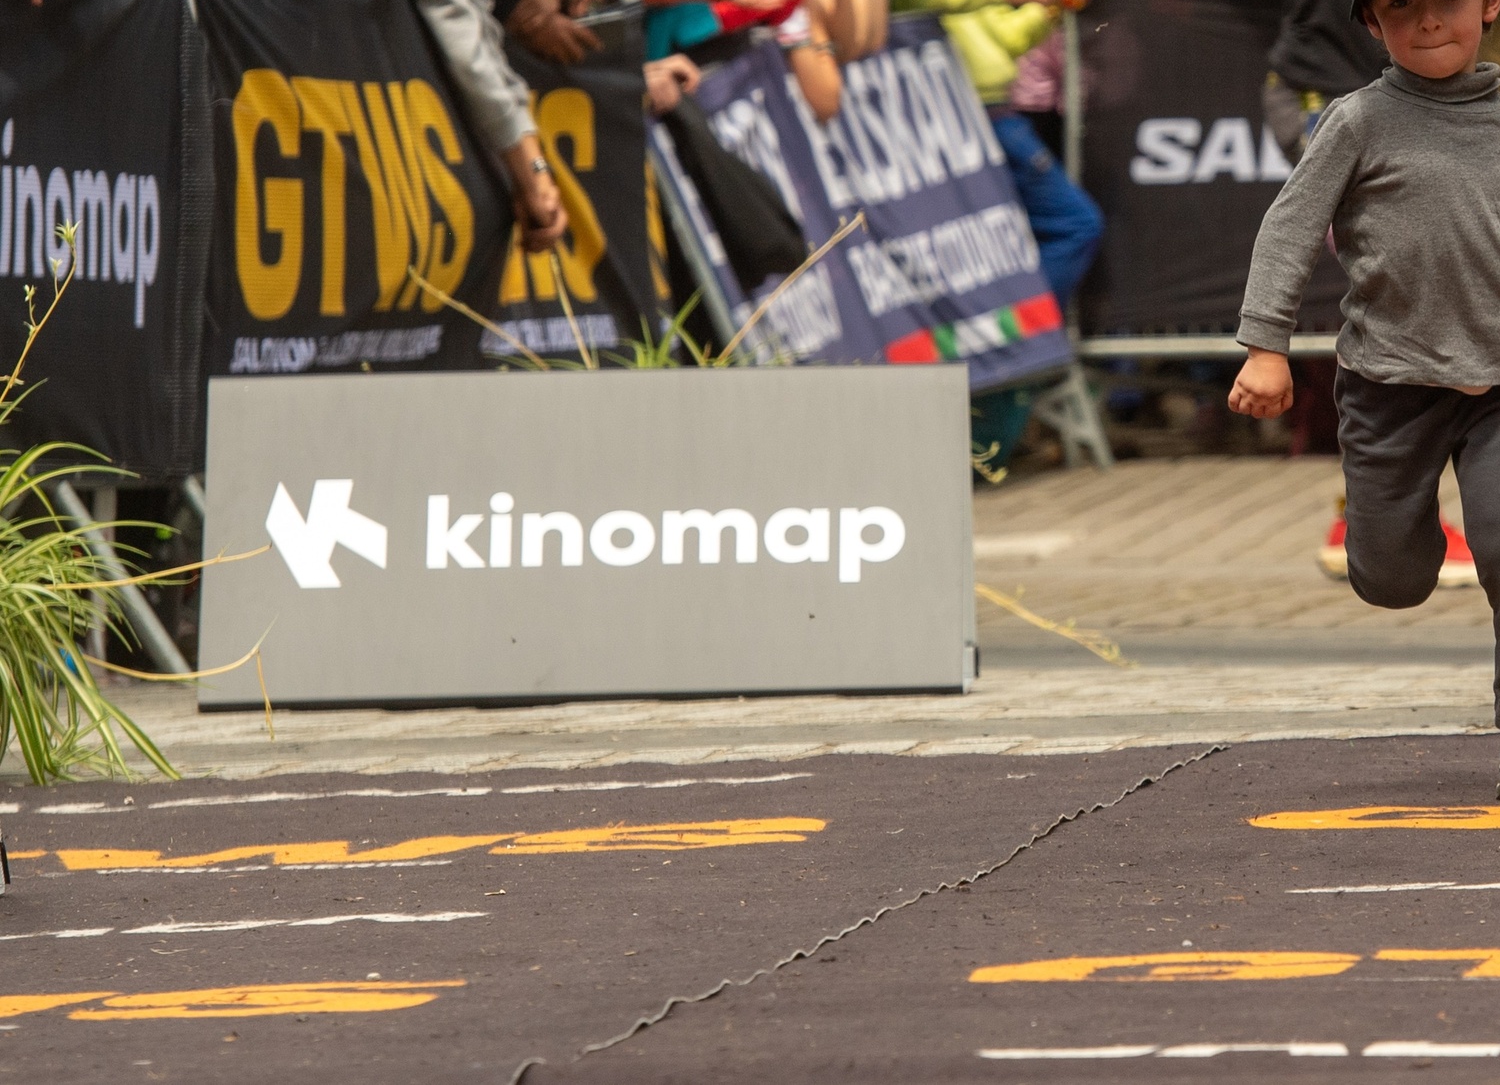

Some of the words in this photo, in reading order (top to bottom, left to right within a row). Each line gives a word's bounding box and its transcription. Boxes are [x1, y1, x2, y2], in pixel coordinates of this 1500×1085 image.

[0, 118, 161, 328] inomap
[232, 68, 475, 321] GTWS
[426, 491, 907, 583] kinomap
